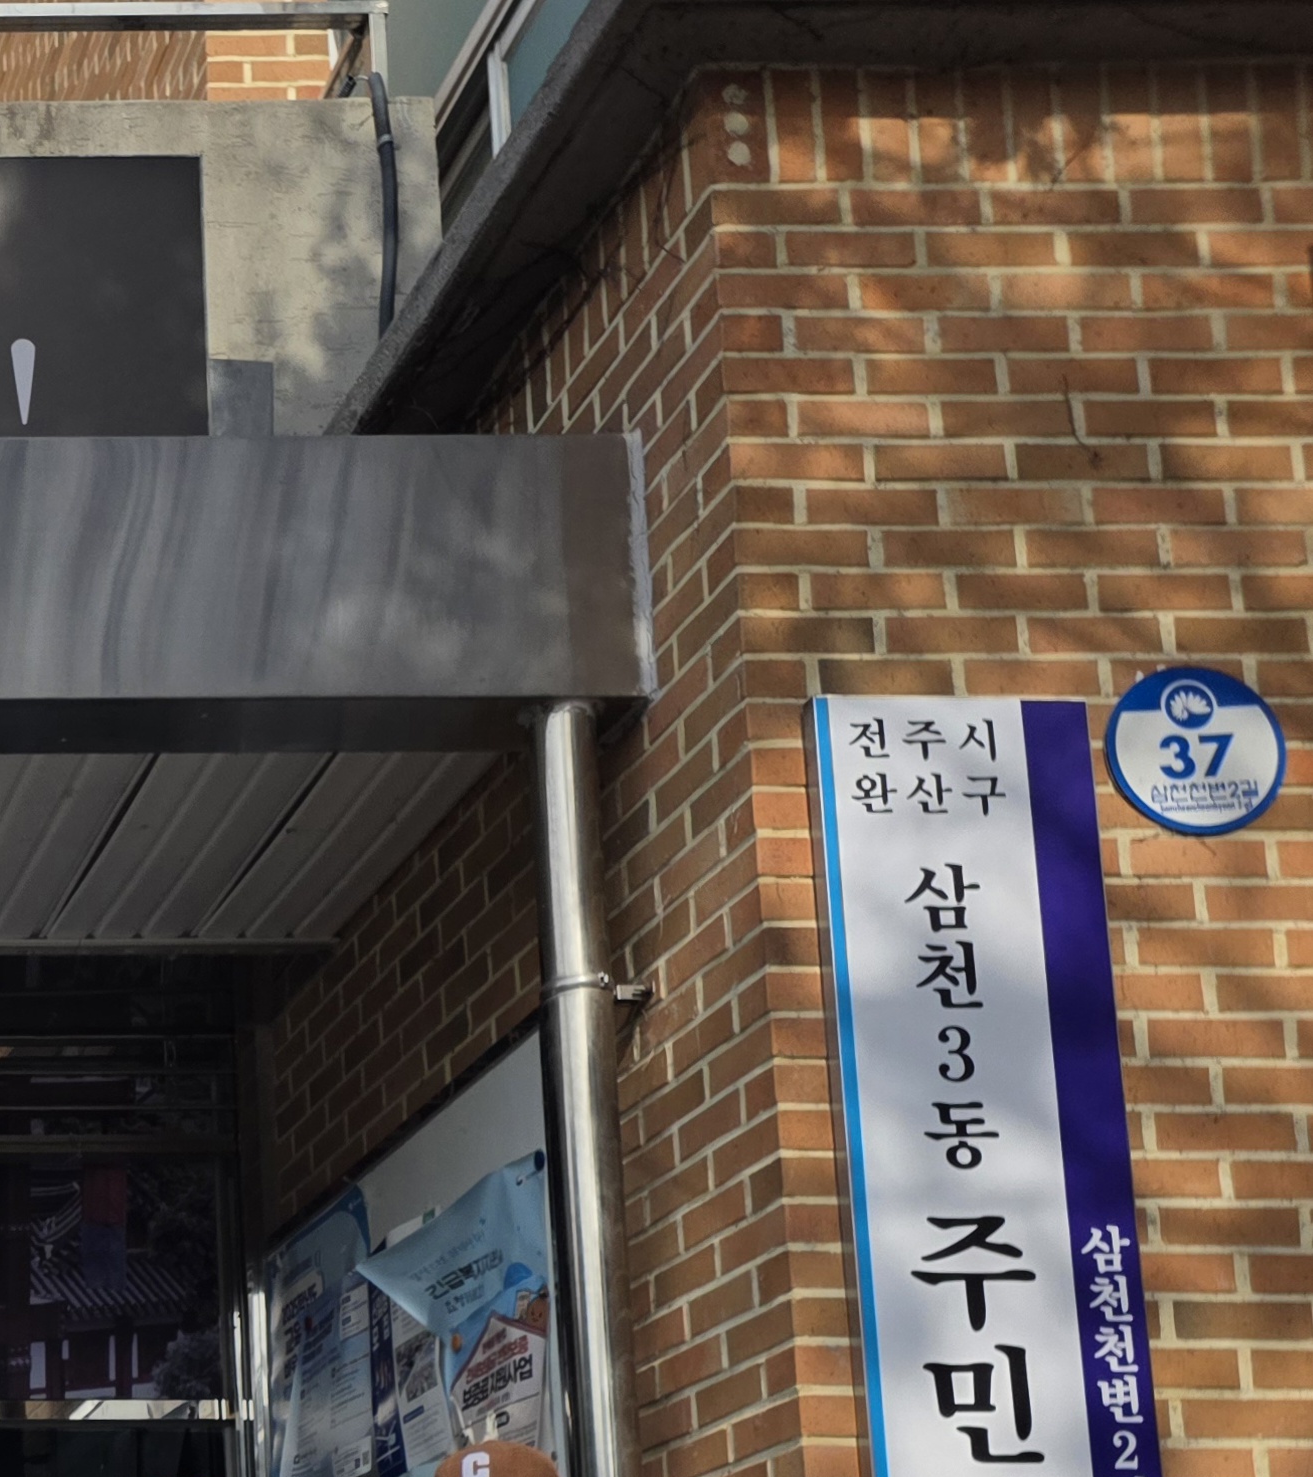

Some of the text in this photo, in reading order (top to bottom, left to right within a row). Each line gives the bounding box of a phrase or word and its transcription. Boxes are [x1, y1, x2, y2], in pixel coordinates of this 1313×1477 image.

[849, 718, 997, 762] 전주시
[1159, 734, 1234, 779] 37
[851, 773, 1007, 817] 완산구
[904, 863, 1000, 1170] 삼천3동
